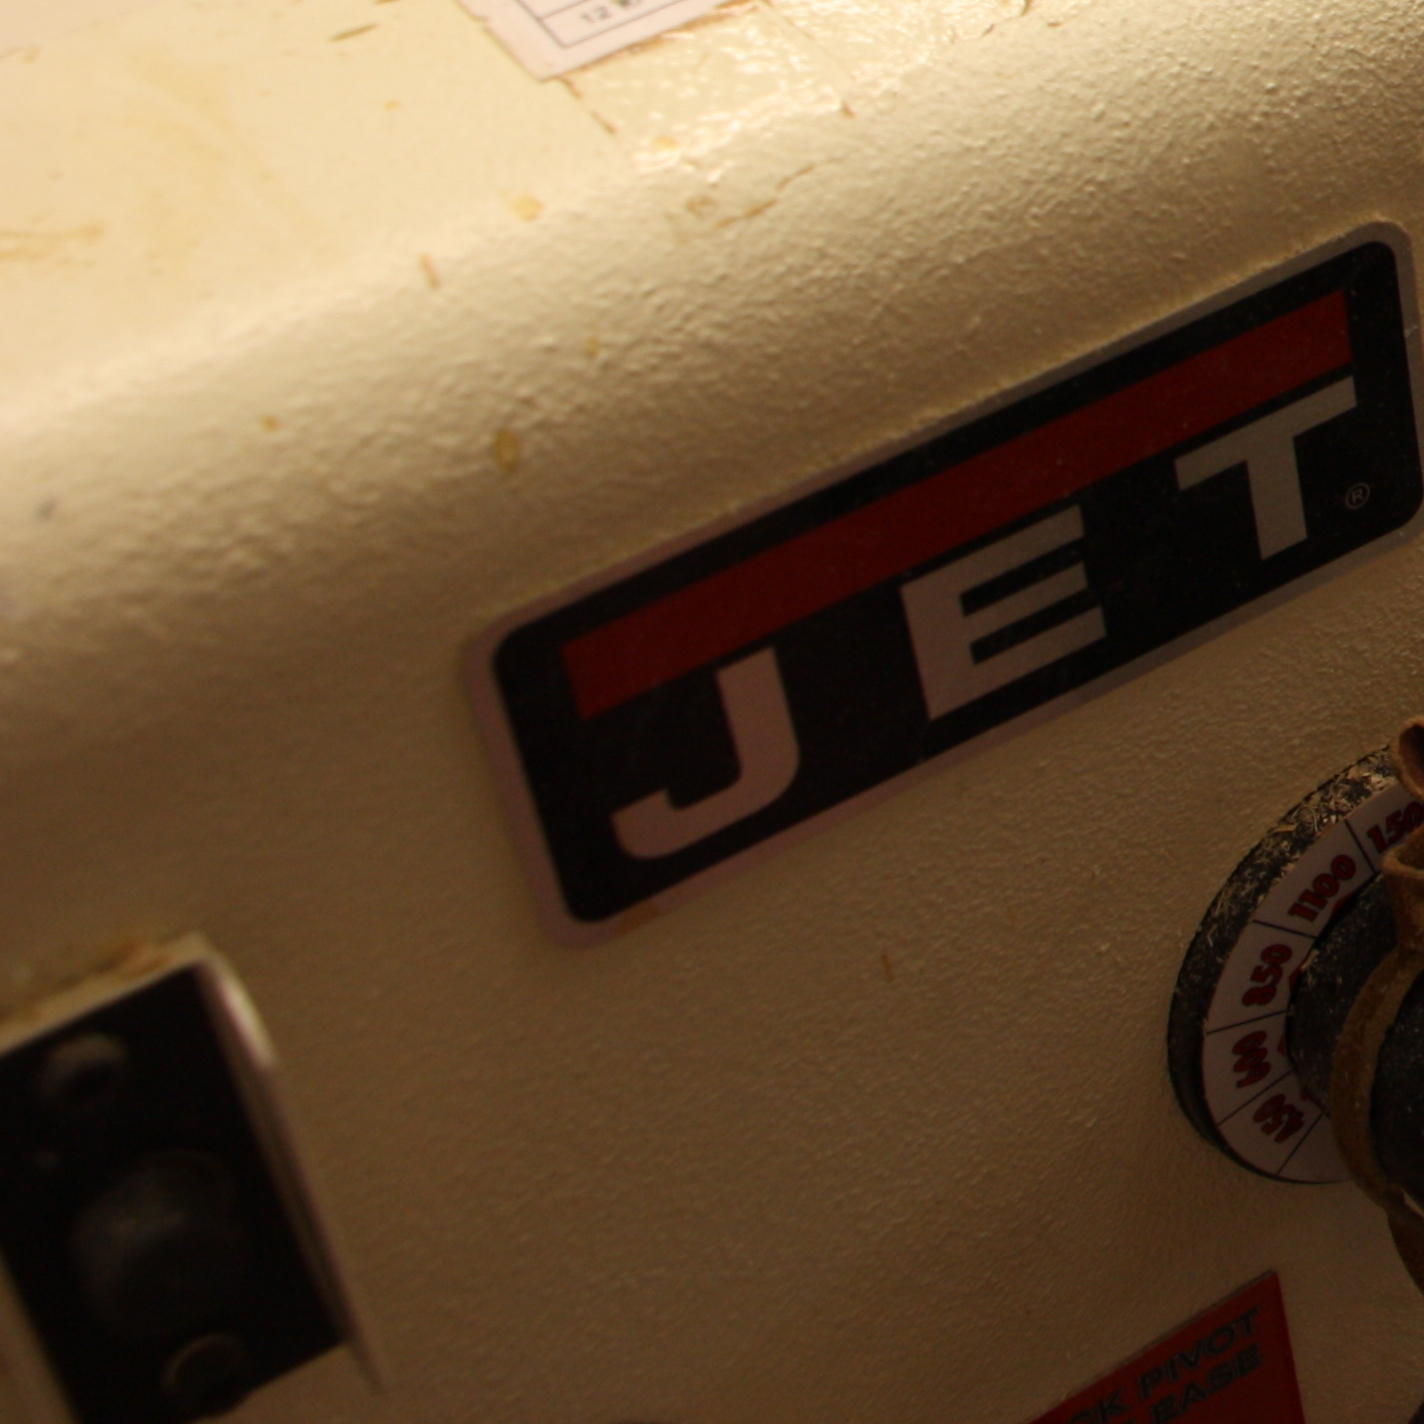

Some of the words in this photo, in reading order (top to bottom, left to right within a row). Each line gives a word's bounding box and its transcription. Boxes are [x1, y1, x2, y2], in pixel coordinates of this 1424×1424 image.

[610, 377, 1357, 861] JET
[1288, 854, 1357, 923] 1100
[1241, 943, 1293, 1008] 850
[1136, 1304, 1263, 1402] PIVOT
